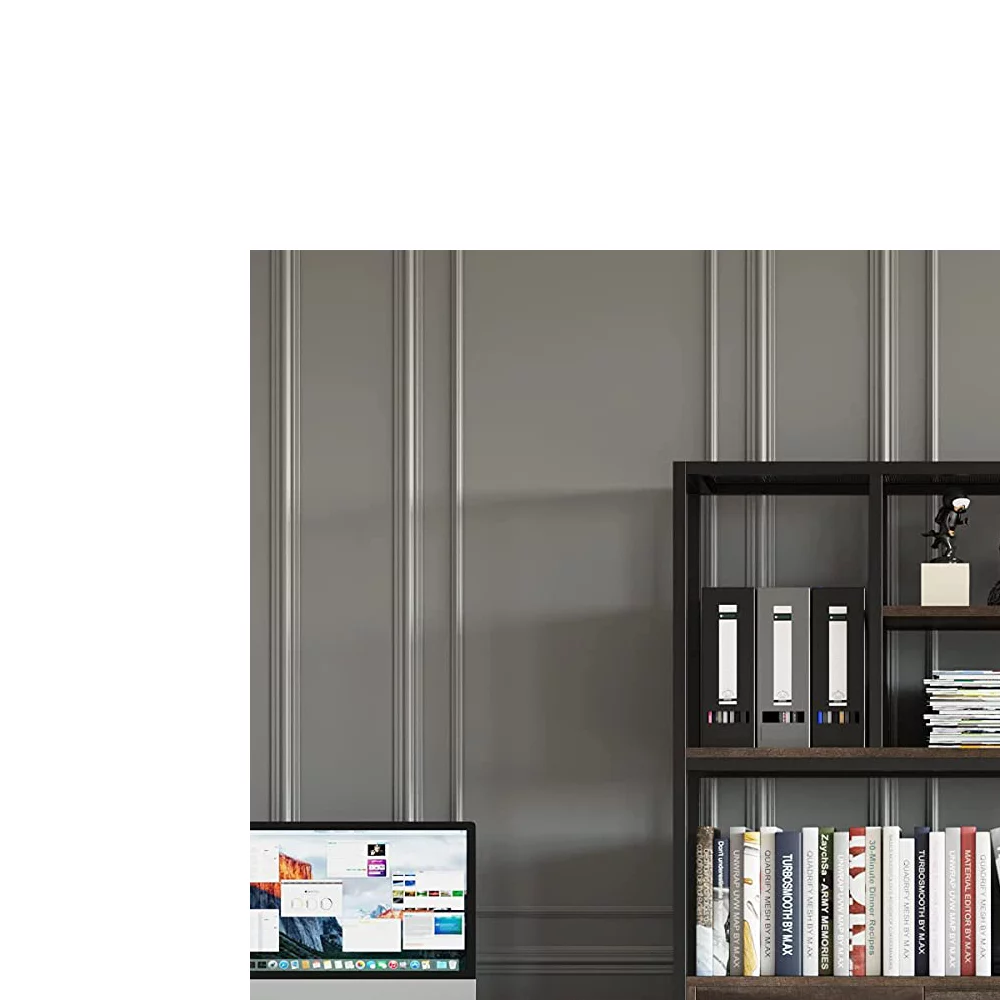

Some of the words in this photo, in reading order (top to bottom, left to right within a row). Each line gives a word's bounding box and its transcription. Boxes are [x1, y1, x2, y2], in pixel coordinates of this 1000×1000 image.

[717, 840, 725, 857] Don't
[819, 833, 829, 876] ZaychSa
[806, 850, 814, 895] QUADRIFY
[964, 849, 972, 892] MATERIAL
[979, 854, 987, 897] QUADRIFY
[782, 853, 793, 920] TURBOSMOOTH
[918, 849, 926, 918] TURBOSMOOTH
[806, 896, 814, 921] MESH
[821, 883, 829, 913] ARMY
[964, 893, 972, 927] EDITOR
[979, 898, 987, 922] MESH
[764, 923, 771, 935] BY
[782, 921, 793, 933] BY
[806, 923, 814, 935] BY
[903, 927, 910, 939] BY
[918, 919, 926, 932] BY
[964, 928, 972, 940] BY
[979, 923, 987, 936] BY
[733, 932, 740, 945] BY
[782, 934, 793, 956] M.AX
[806, 936, 814, 958] M.AX
[821, 915, 829, 970] MEMORIES
[837, 934, 844, 946] BY
[868, 919, 876, 956] Recipes
[918, 933, 926, 955] M.AX
[949, 932, 956, 945] BY
[964, 941, 972, 963] M.AX
